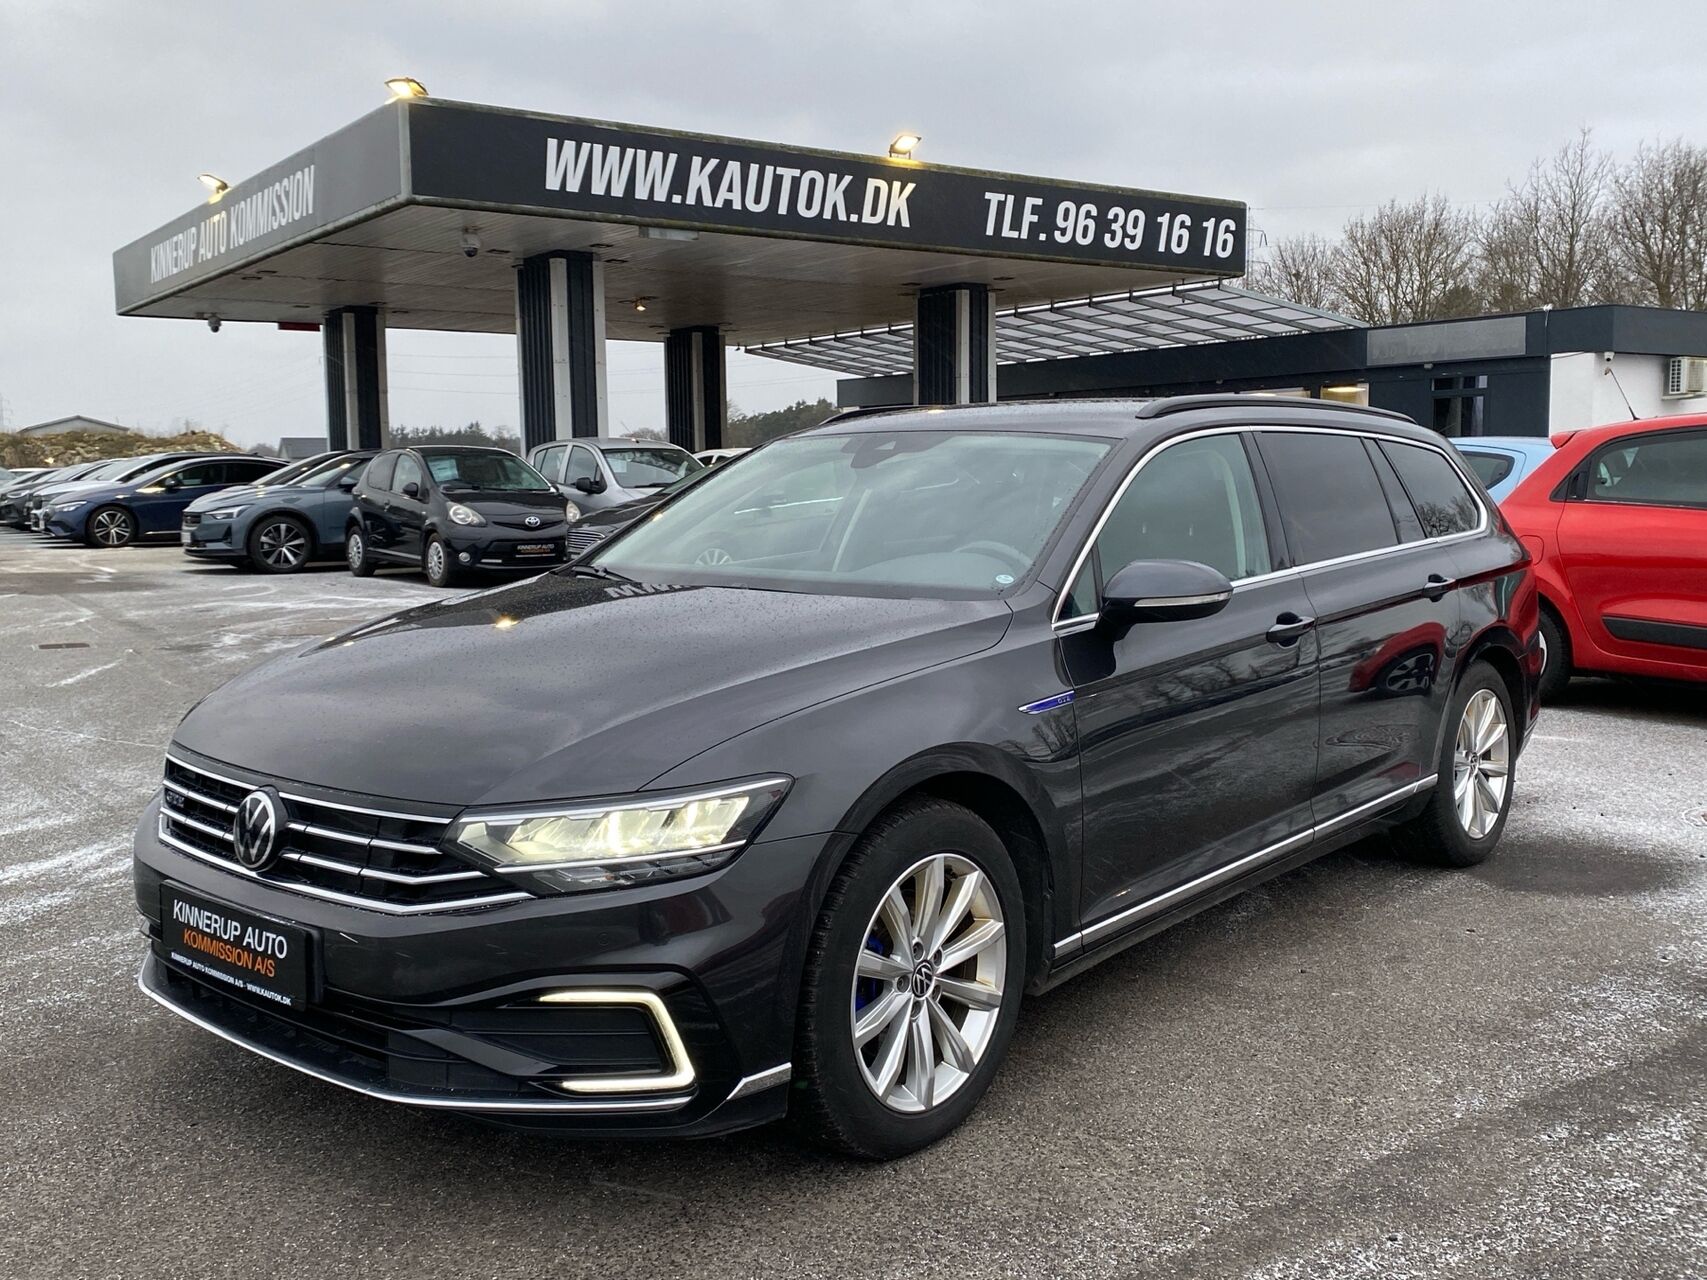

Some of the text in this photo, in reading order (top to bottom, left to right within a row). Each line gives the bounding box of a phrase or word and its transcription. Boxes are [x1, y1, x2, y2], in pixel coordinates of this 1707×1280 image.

[544, 137, 916, 228] WWW.KAUTOK.DK
[150, 164, 315, 284] KINNERUP AUTO KOMMISSION
[984, 191, 1237, 260] TLF. 96 39 16 16
[172, 898, 288, 959] KINNERUP AUTO
[183, 927, 275, 978] KOMMISSION A/S
[170, 951, 192, 967] KINNERUP
[192, 961, 204, 973] AUTO
